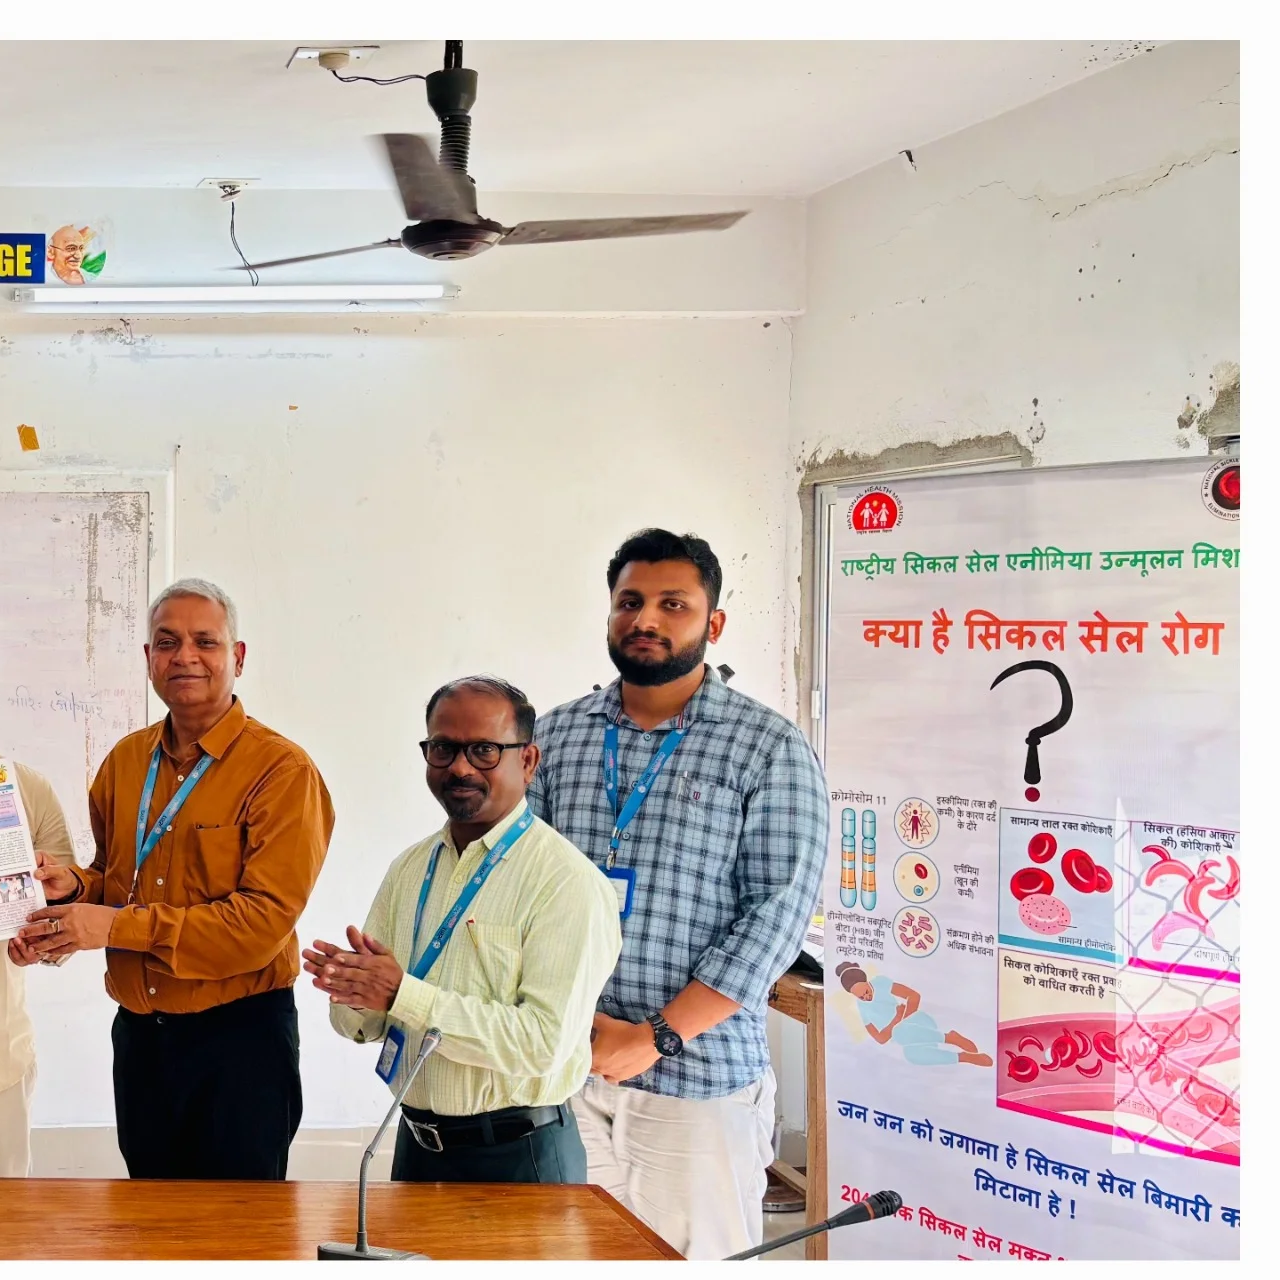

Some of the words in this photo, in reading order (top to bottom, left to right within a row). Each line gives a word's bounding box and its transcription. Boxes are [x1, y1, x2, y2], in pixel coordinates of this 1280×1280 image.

[846, 492, 864, 530] NATIONAL
[864, 485, 893, 494] HEALTH
[891, 492, 904, 527] MISSION
[841, 552, 895, 580] राष्ट्रीय
[903, 551, 957, 574] सिकल
[965, 549, 998, 573] सेल
[1006, 546, 1092, 571] एनीमिया
[1100, 548, 1183, 576] उन्मूलन
[863, 619, 923, 648] क्या
[932, 608, 953, 654] है
[964, 609, 1067, 652] सिकल
[1078, 610, 1148, 654] सेल
[1161, 610, 1225, 656] रोग
[831, 789, 873, 805] क्रोमोसोम
[877, 796, 886, 805] 11
[987, 799, 997, 810] की
[956, 807, 964, 818] के
[966, 810, 985, 820] कारण
[986, 811, 997, 822] दर्द
[957, 818, 965, 829] के
[1010, 816, 1039, 827] सामान्य
[1042, 819, 1060, 829] लाल
[1062, 821, 1078, 832] रक्त
[1144, 821, 1174, 834] सिकल
[1160, 836, 1177, 849] की)
[969, 877, 979, 887] की
[984, 934, 995, 945] की
[1004, 957, 1031, 972] सिकल
[1081, 971, 1100, 983] रक्त
[1023, 974, 1035, 987] को
[1069, 983, 1095, 997] करती
[1097, 985, 1105, 999] है
[838, 1100, 868, 1124] जन
[874, 1109, 904, 1134] जन
[910, 1118, 933, 1142] को
[939, 1130, 998, 1160] जगाना
[1025, 1148, 1090, 1187] सिकल
[1097, 1169, 1135, 1199] सेल
[1143, 1179, 1212, 1223] बिमारी
[974, 1168, 1041, 1209] मिटाना
[919, 1206, 968, 1241] सिकल
[972, 1227, 1002, 1253] सेल
